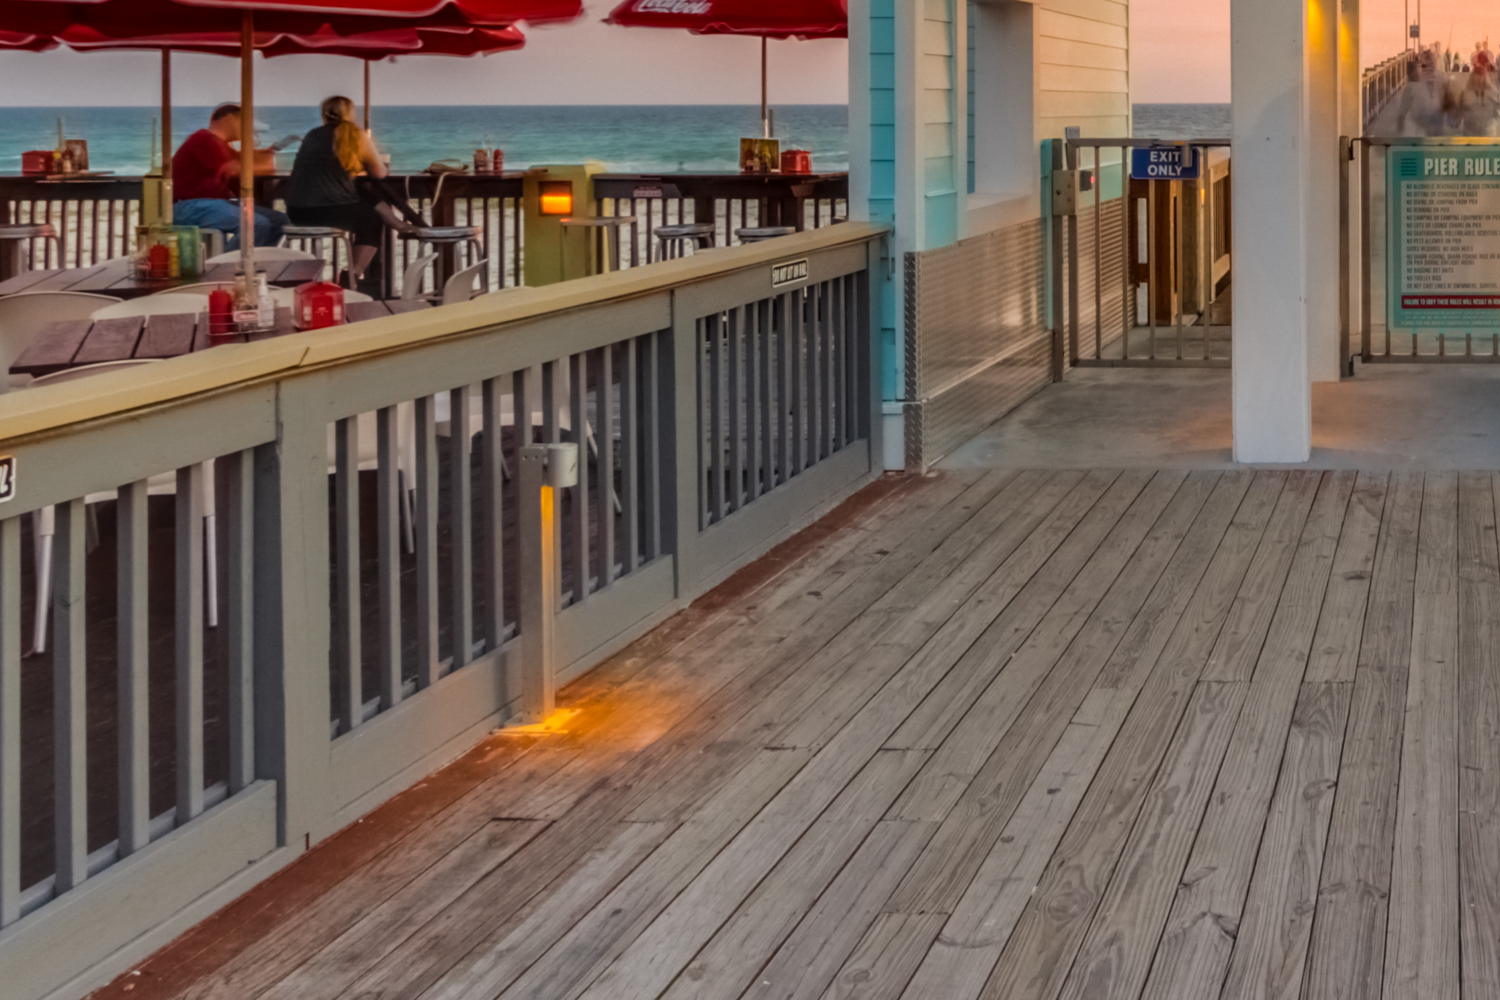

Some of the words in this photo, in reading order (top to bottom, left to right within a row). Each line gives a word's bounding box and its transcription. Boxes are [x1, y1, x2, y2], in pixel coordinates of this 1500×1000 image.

[1150, 151, 1181, 162] EXIT
[1147, 165, 1182, 176] ONLY
[1424, 158, 1458, 176] PIER
